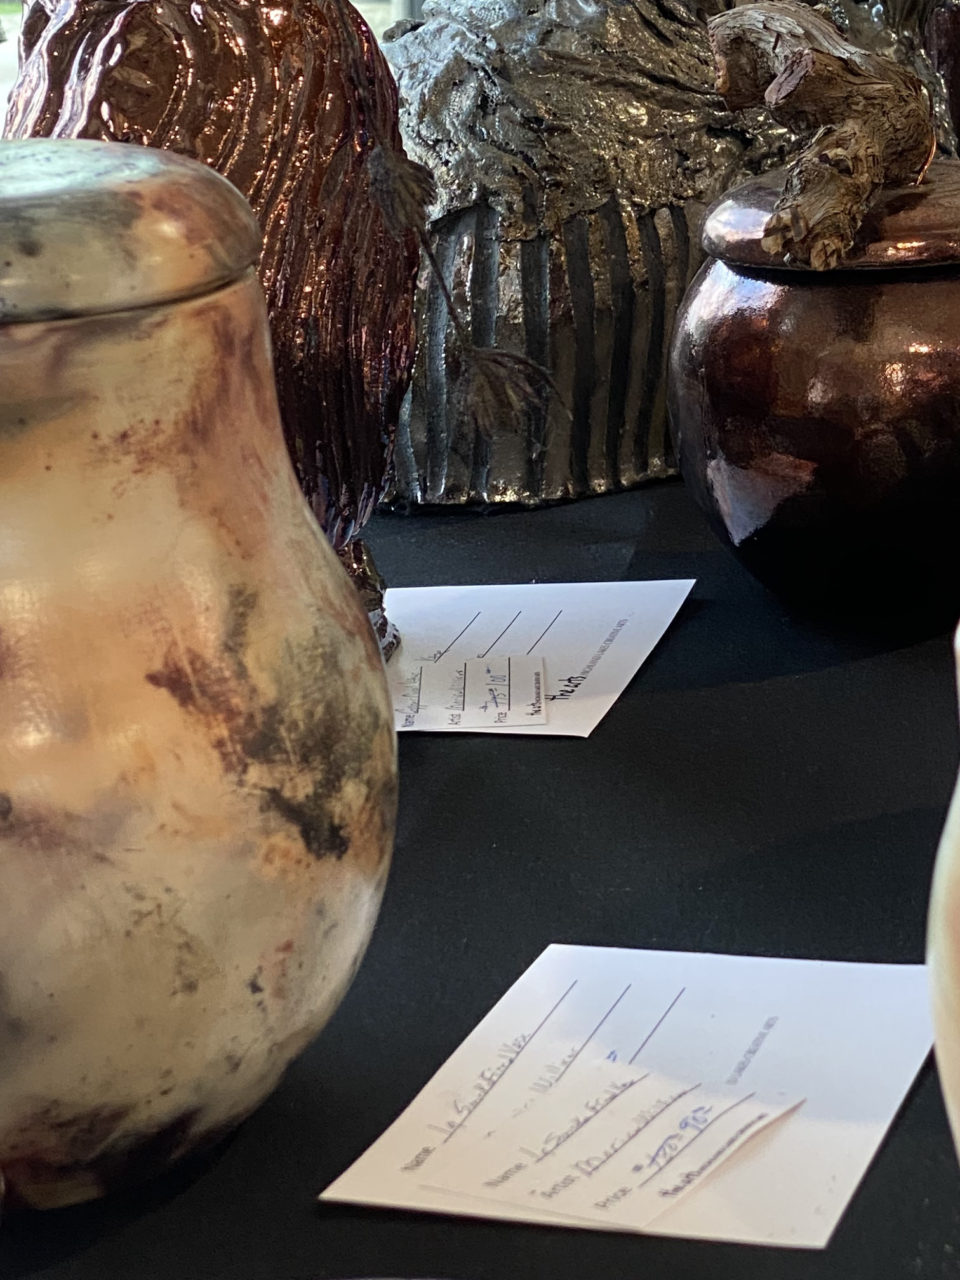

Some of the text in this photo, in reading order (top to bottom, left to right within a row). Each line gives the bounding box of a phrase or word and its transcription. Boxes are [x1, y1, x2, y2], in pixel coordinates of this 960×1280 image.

[401, 1143, 436, 1175] Name
[484, 1160, 529, 1188] Name
[593, 1185, 634, 1210] Price
